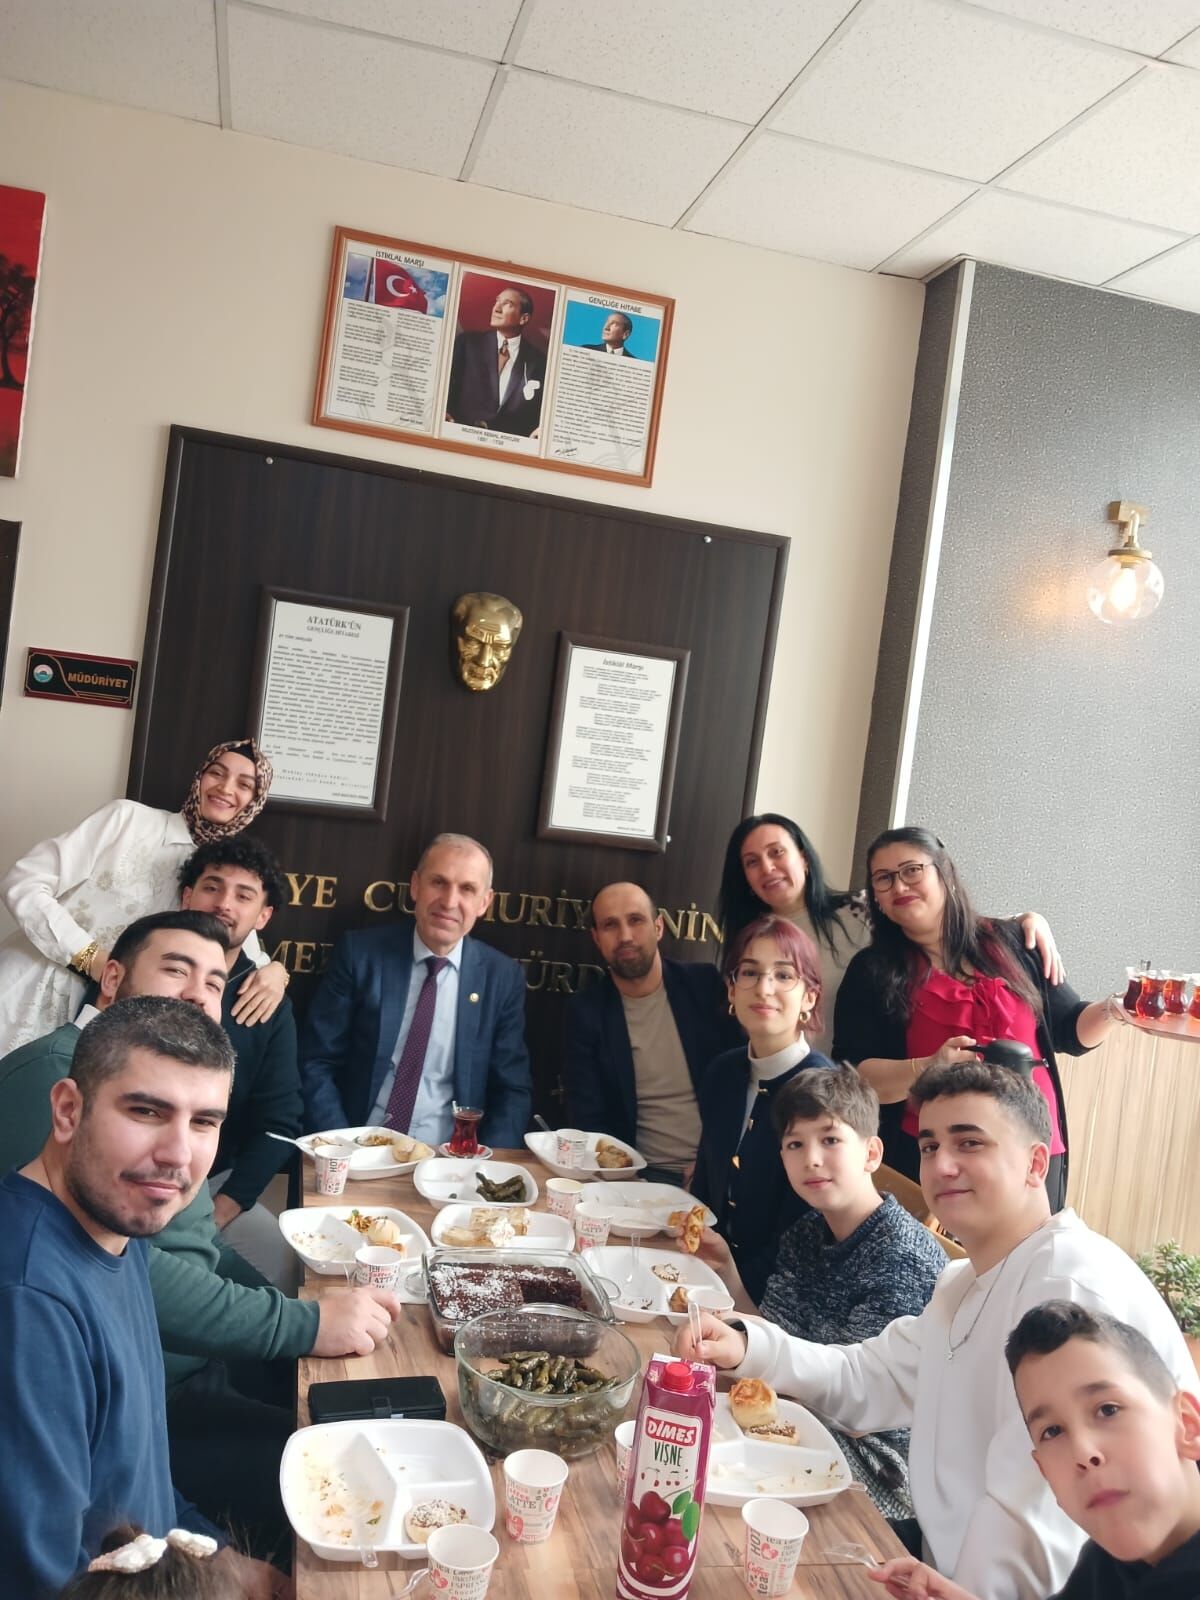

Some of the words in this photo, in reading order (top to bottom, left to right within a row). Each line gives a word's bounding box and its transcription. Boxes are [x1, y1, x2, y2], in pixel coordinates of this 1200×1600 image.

[67, 671, 129, 689] MÜDÜRİYET
[647, 1419, 694, 1445] DİMES
[654, 1441, 684, 1467] VİŞNE
